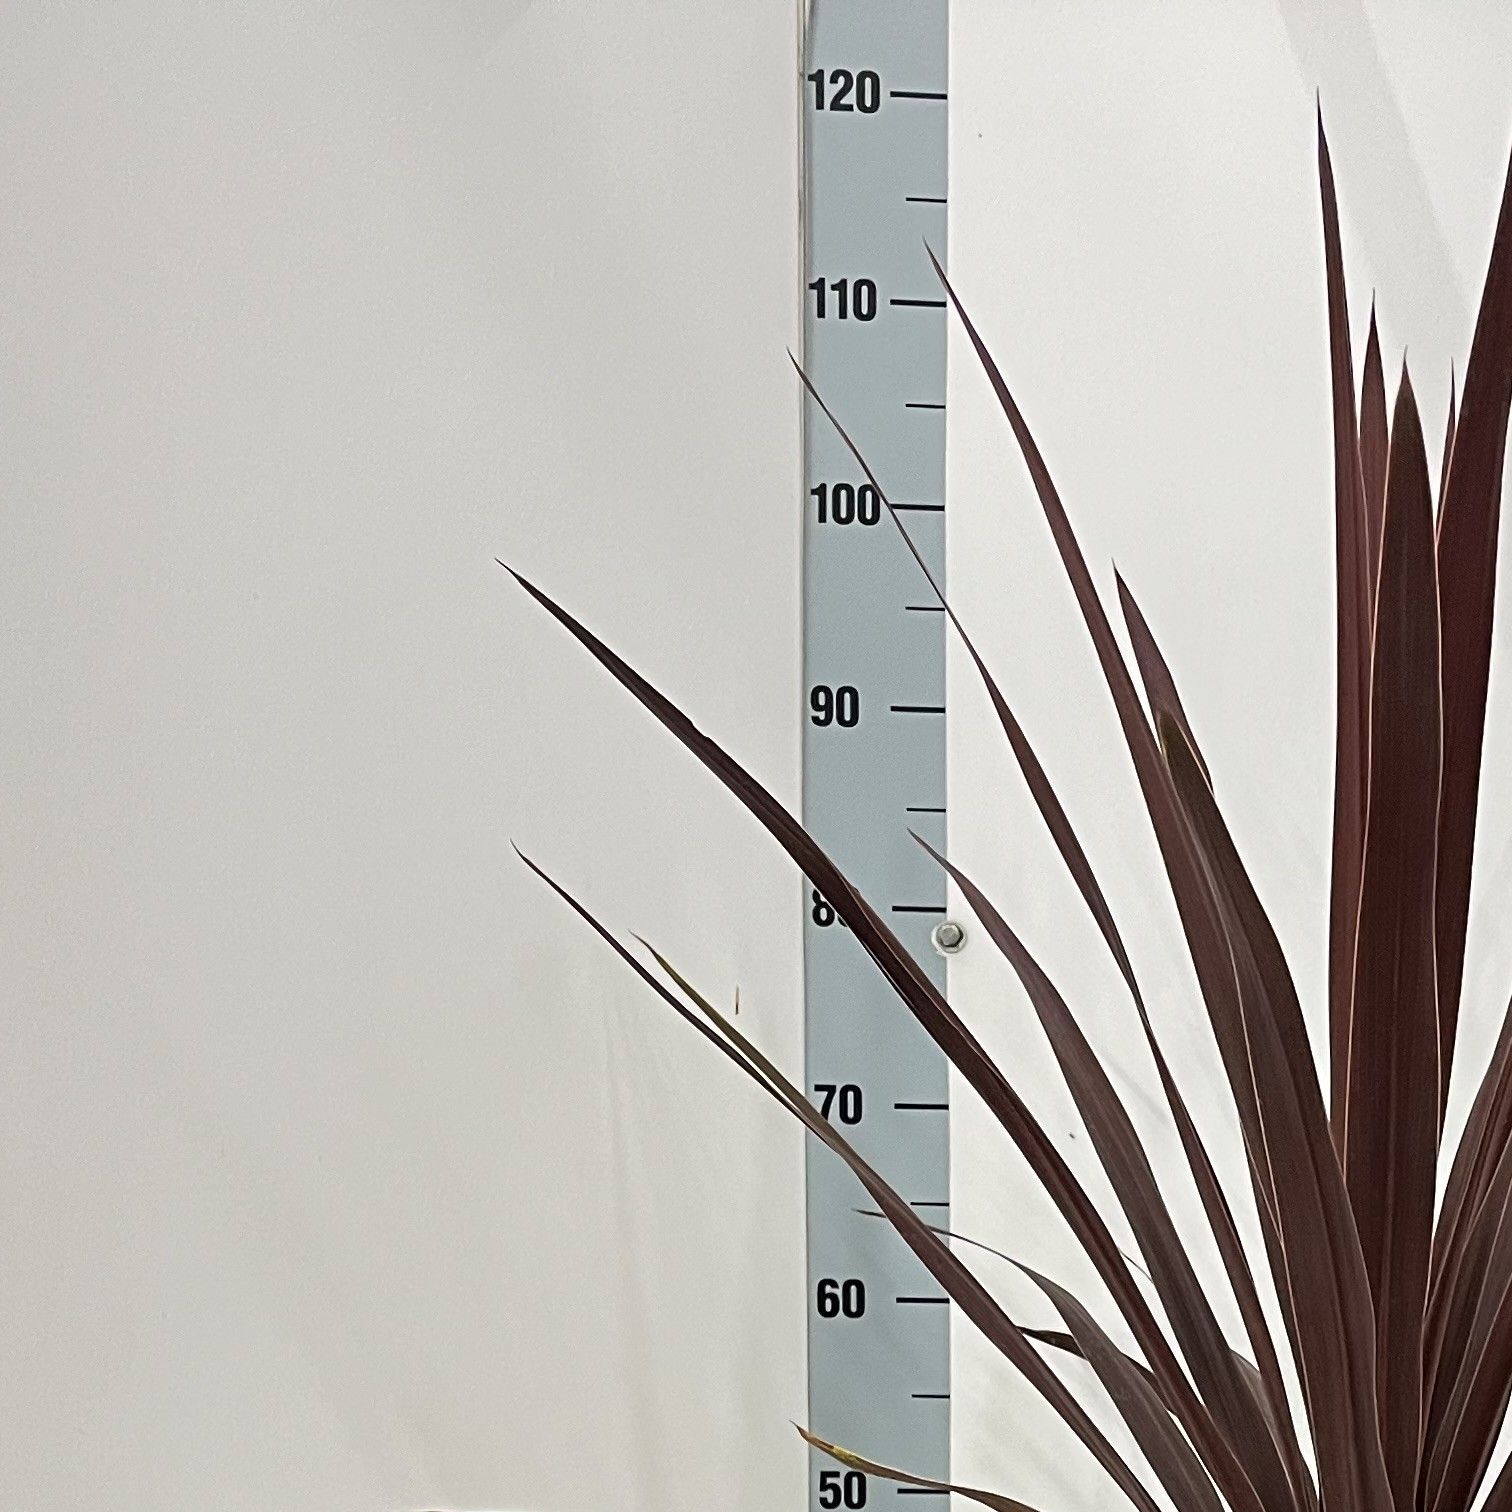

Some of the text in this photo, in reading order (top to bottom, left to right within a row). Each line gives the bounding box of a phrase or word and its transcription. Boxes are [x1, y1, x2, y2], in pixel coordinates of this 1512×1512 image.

[808, 68, 881, 113] 120
[808, 278, 877, 321] 110
[810, 483, 882, 526] 100
[811, 685, 860, 727] 90
[812, 888, 854, 927] 8
[814, 1084, 863, 1125] 70
[816, 1279, 866, 1318] 60
[819, 1470, 867, 1510] 50
